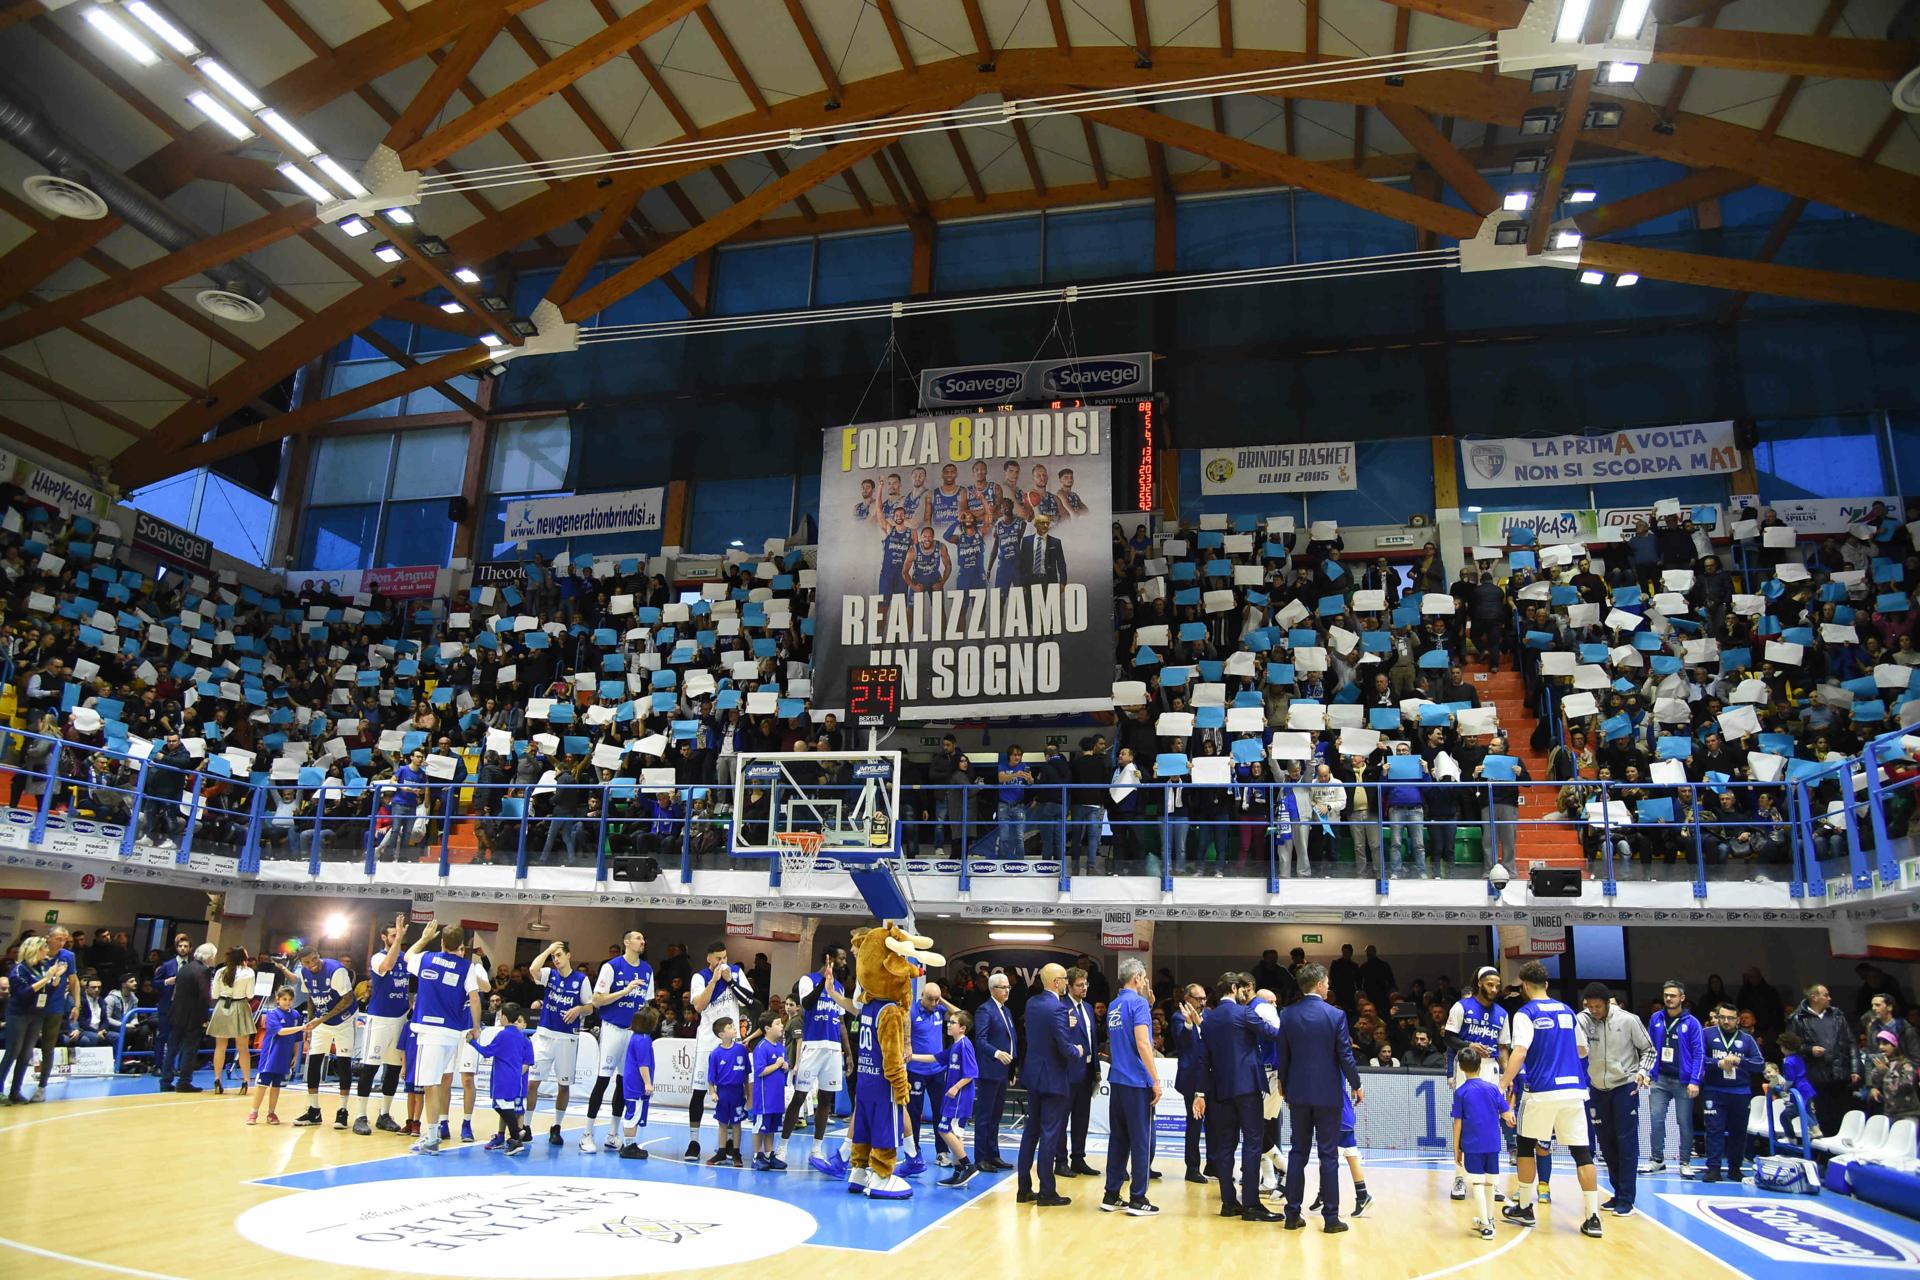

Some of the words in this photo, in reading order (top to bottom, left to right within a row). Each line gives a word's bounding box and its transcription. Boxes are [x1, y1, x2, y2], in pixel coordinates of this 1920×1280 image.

[945, 375, 1021, 394] Soavegel
[1060, 366, 1138, 386] Soavegel
[1139, 402, 1152, 411] 88
[841, 422, 940, 472] FORZA
[1532, 440, 1558, 457] LA
[1564, 434, 1635, 457] PRIMA
[1637, 429, 1708, 449] VOLTA
[1237, 449, 1295, 469] BRINDISI
[1300, 446, 1352, 466] BASKET
[1515, 464, 1559, 481] NON
[1564, 462, 1583, 477] SI
[1593, 454, 1682, 477] SCORDA
[1258, 472, 1291, 484] CLUB
[1295, 471, 1329, 483] 2005
[1740, 500, 1748, 509] E
[137, 514, 208, 561] Soavegel
[395, 569, 434, 583] Angus
[841, 583, 1088, 646] REALIZZIAMO
[861, 668, 897, 682] 6:22
[931, 641, 1061, 700] SOGNO
[851, 685, 894, 713] 24
[973, 863, 997, 872] Soavegel
[1005, 863, 1029, 872] Soavegel
[1104, 912, 1131, 923] UNIBED
[1532, 916, 1562, 928] UNIBED
[727, 926, 753, 935] BRINDISI
[1103, 936, 1133, 946] BRINDISI
[1532, 941, 1566, 951] BRINDISI
[859, 1026, 873, 1051] 00
[653, 1083, 677, 1094] HOTEL
[356, 1185, 595, 1242] PAOLOLEO
[409, 1190, 640, 1252] CANTINE
[1738, 1206, 1897, 1260] Soavegel
